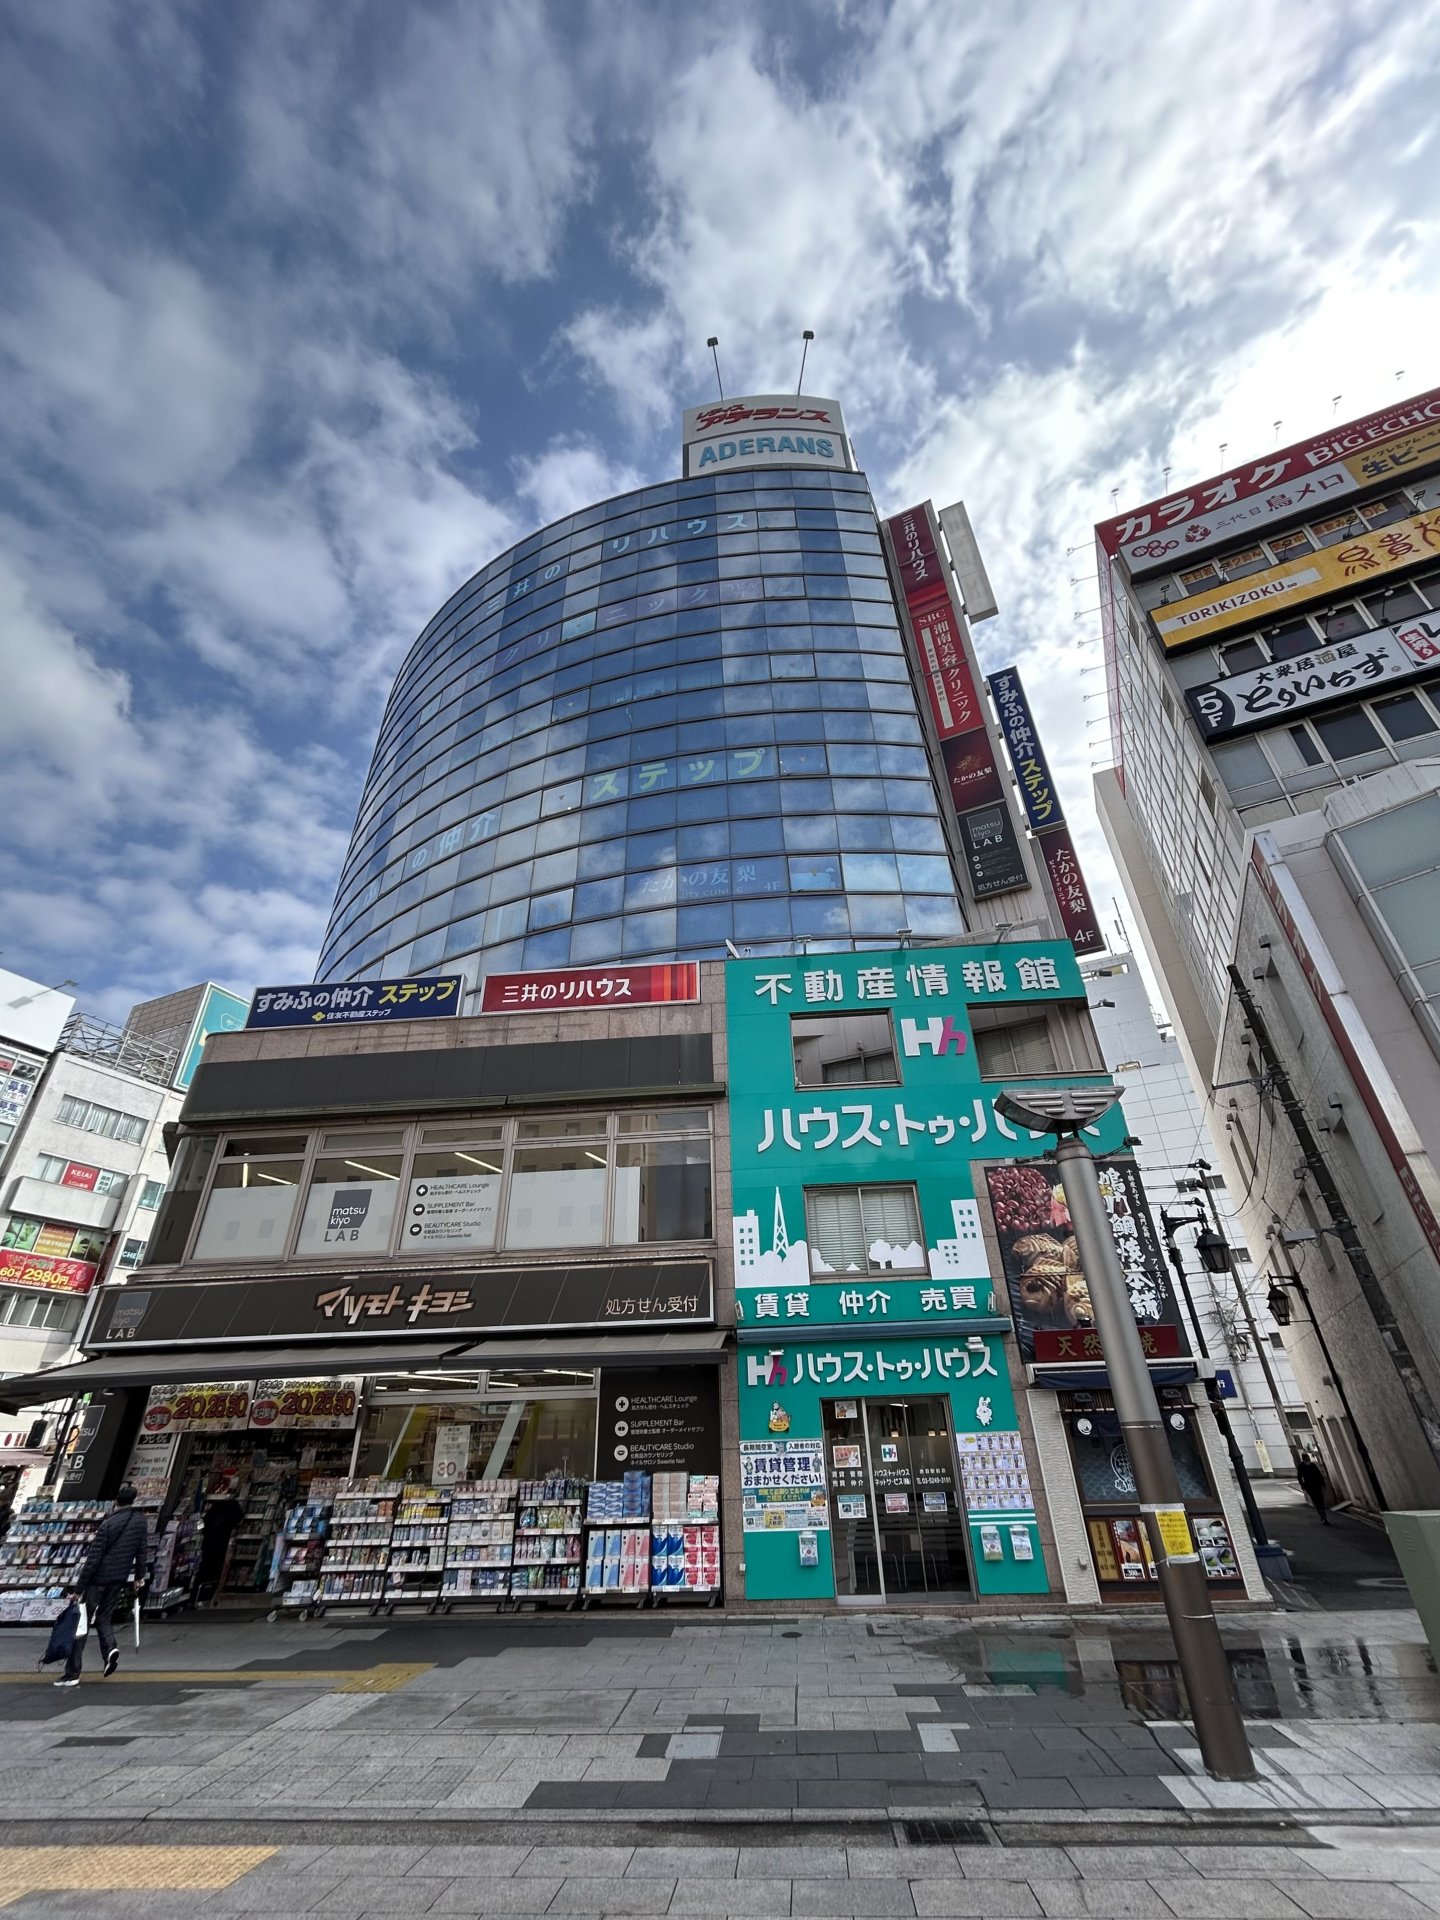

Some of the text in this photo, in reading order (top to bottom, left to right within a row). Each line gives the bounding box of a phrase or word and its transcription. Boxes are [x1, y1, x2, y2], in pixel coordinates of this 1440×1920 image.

[696, 408, 831, 431] アデランス
[699, 436, 835, 467] ADERANS
[1304, 434, 1365, 467] BIG
[1115, 457, 1292, 543] カラオケ
[902, 514, 928, 581] 三井のリハウス
[1177, 581, 1284, 625] TORIKIZOKU
[919, 609, 946, 625] SBC
[1256, 643, 1359, 684] 大衆居酒屋
[934, 621, 971, 724] 湘南美容クリニック
[994, 675, 1053, 820] すみふの仲介 ステップ
[953, 766, 992, 784] たかの友梨
[972, 820, 1001, 832] matsu
[973, 829, 991, 839] kiyo
[972, 834, 1003, 849] LAB
[978, 874, 1023, 891] 処方せん受付
[1056, 849, 1087, 914] たかの友梨
[1074, 929, 1094, 943] 4F
[755, 957, 1061, 1005] 不動産情報館
[257, 980, 457, 1013] すみふの仲介 ステップ
[502, 978, 631, 1003] 三井のリハウス
[326, 1008, 391, 1020] 住友不動産ステップ
[70, 1169, 93, 1179] KEIAI
[332, 1205, 366, 1215] matsu
[330, 1215, 351, 1228] kiyo
[324, 1229, 360, 1242] LAB
[22, 1268, 69, 1285] 2980円
[317, 1284, 474, 1325] マツモトキヨシ
[605, 1295, 699, 1315] 処方せん受付
[754, 1286, 977, 1318] 賃貸 仲介 売買
[117, 1308, 144, 1316] matsu
[106, 1328, 136, 1339] LAB
[793, 1346, 998, 1385] ハウス・トゥ・ハウス
[631, 1395, 698, 1404] HEALTHCARE Lounge
[630, 1442, 694, 1452] BEAUTYCARE Studio
[754, 1457, 811, 1473] 賃貸管理
[744, 1473, 822, 1486] おまかせください!
